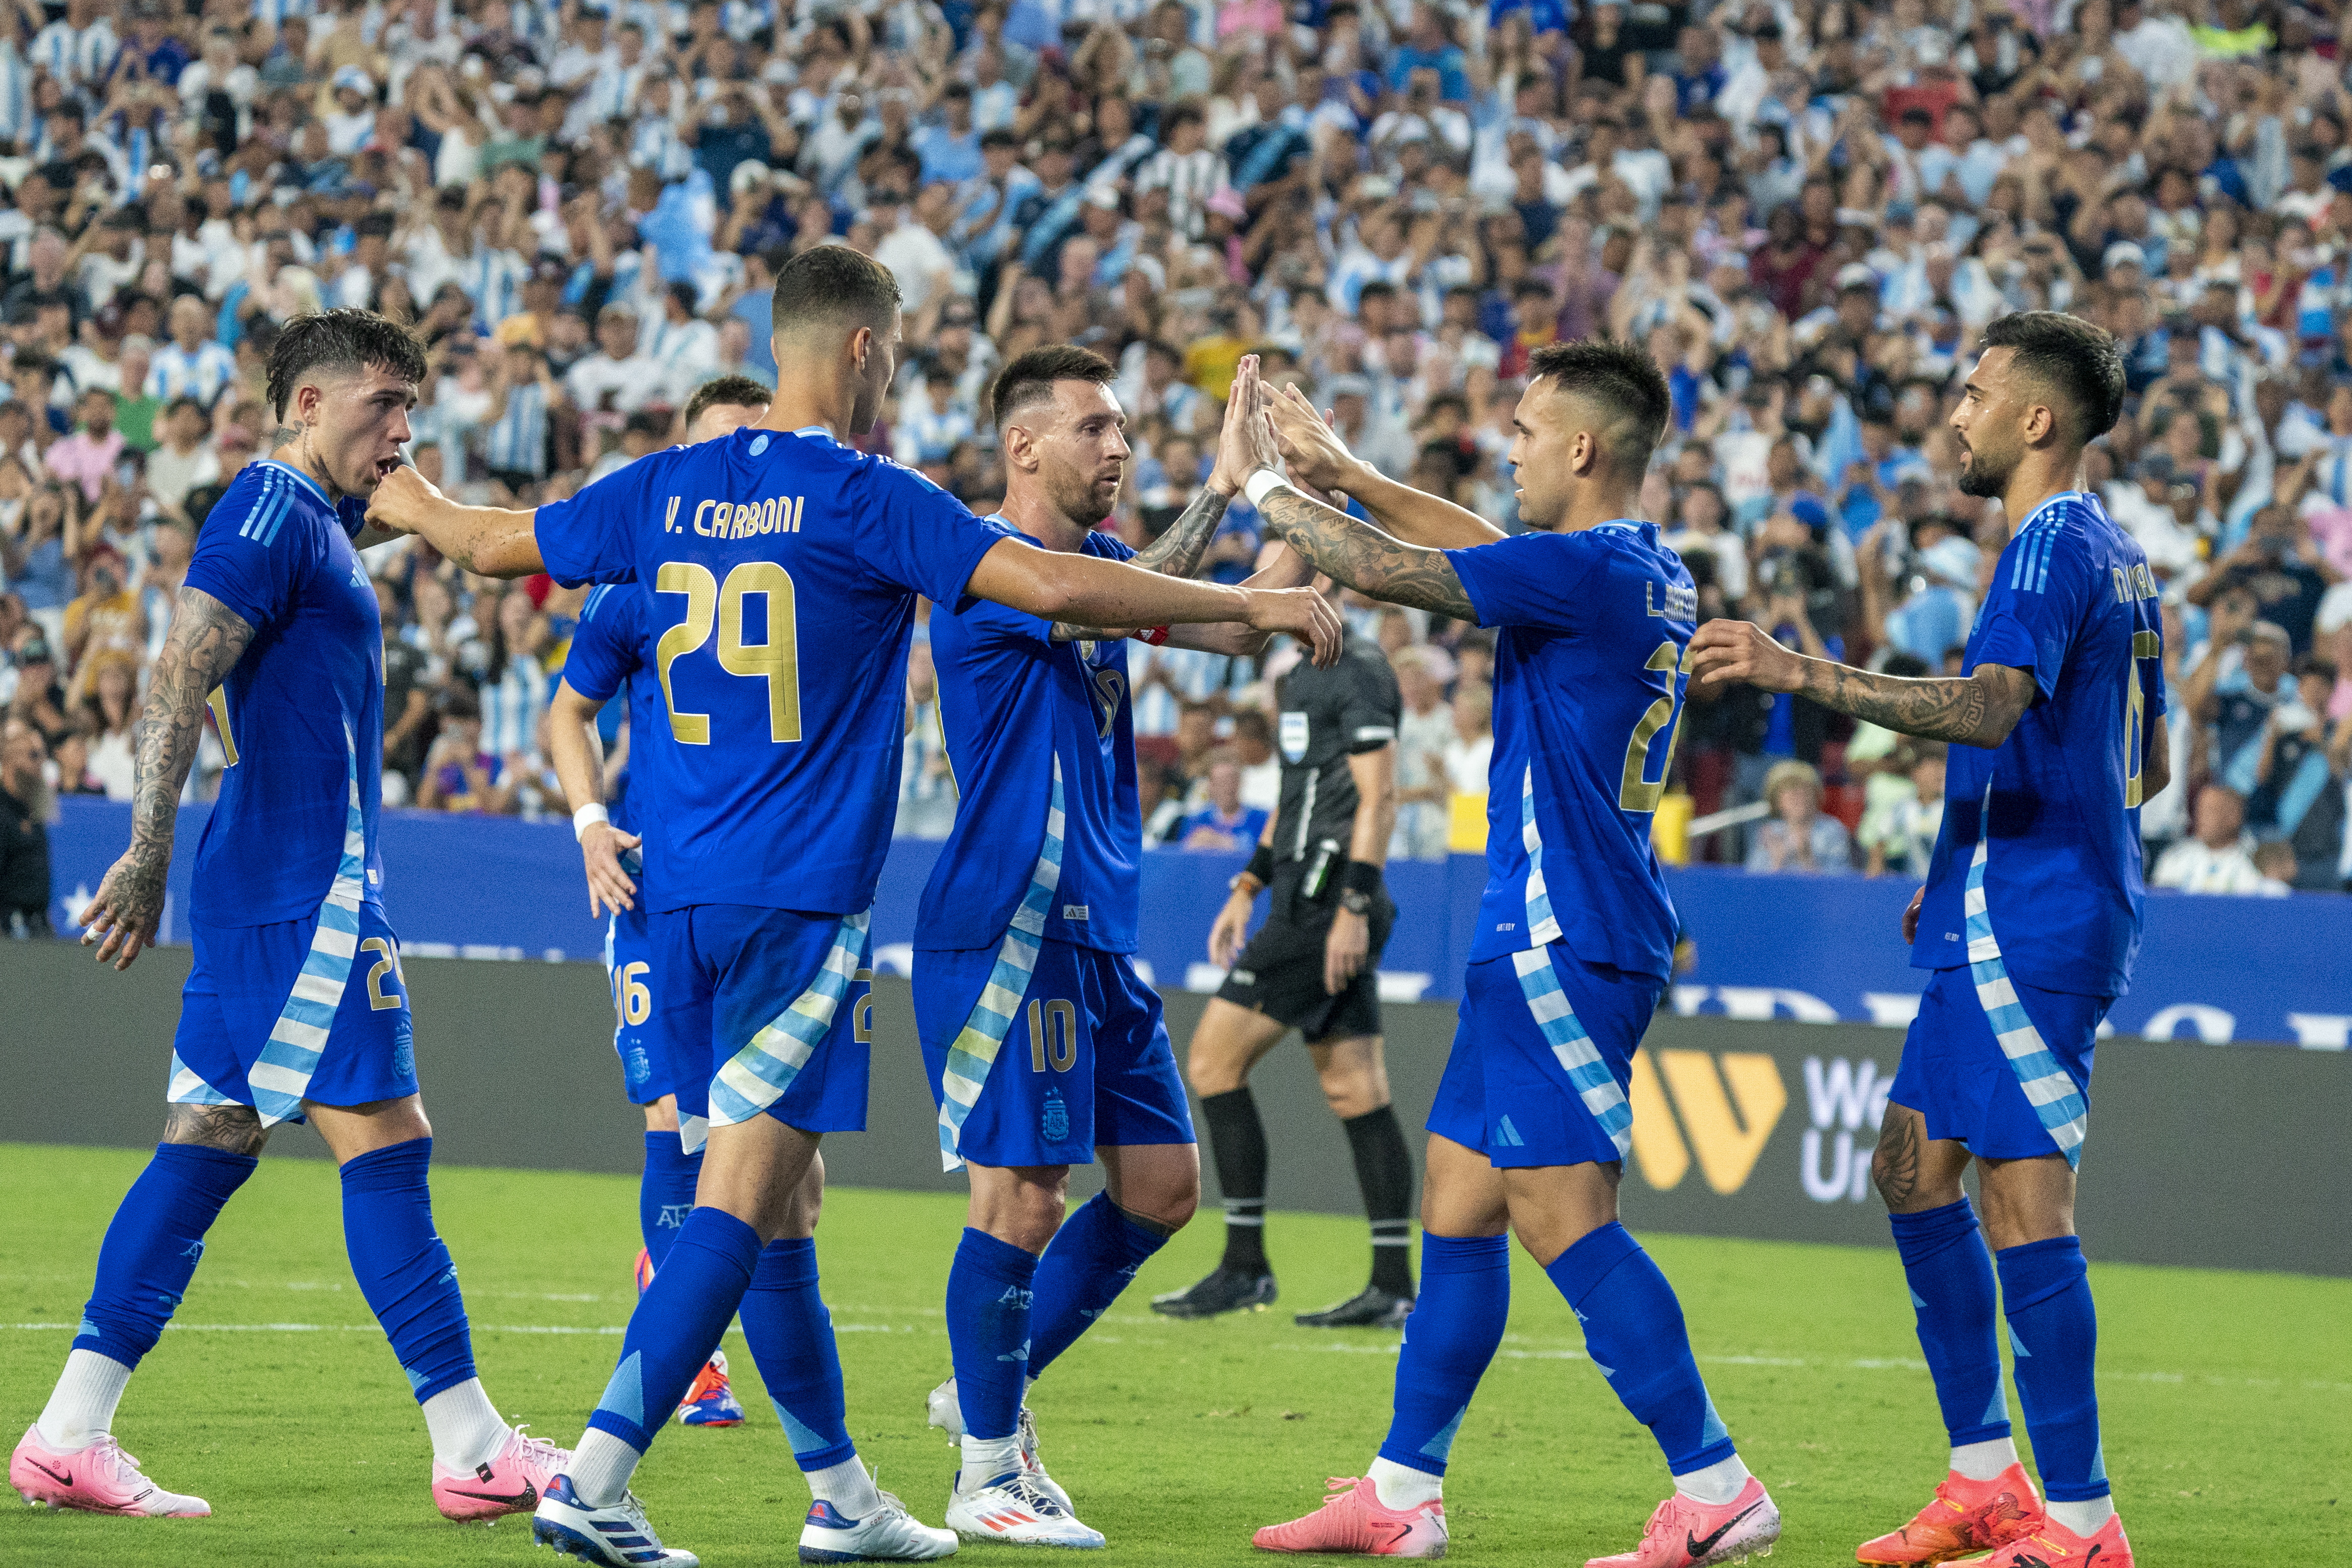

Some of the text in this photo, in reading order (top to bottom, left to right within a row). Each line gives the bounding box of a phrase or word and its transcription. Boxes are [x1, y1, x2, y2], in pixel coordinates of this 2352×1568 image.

[665, 496, 804, 539] V. CARBONI
[656, 562, 801, 745] 29
[1619, 641, 1691, 814] 2
[360, 937, 405, 1011] 2
[614, 961, 651, 1030] 16
[1028, 998, 1077, 1072] 10
